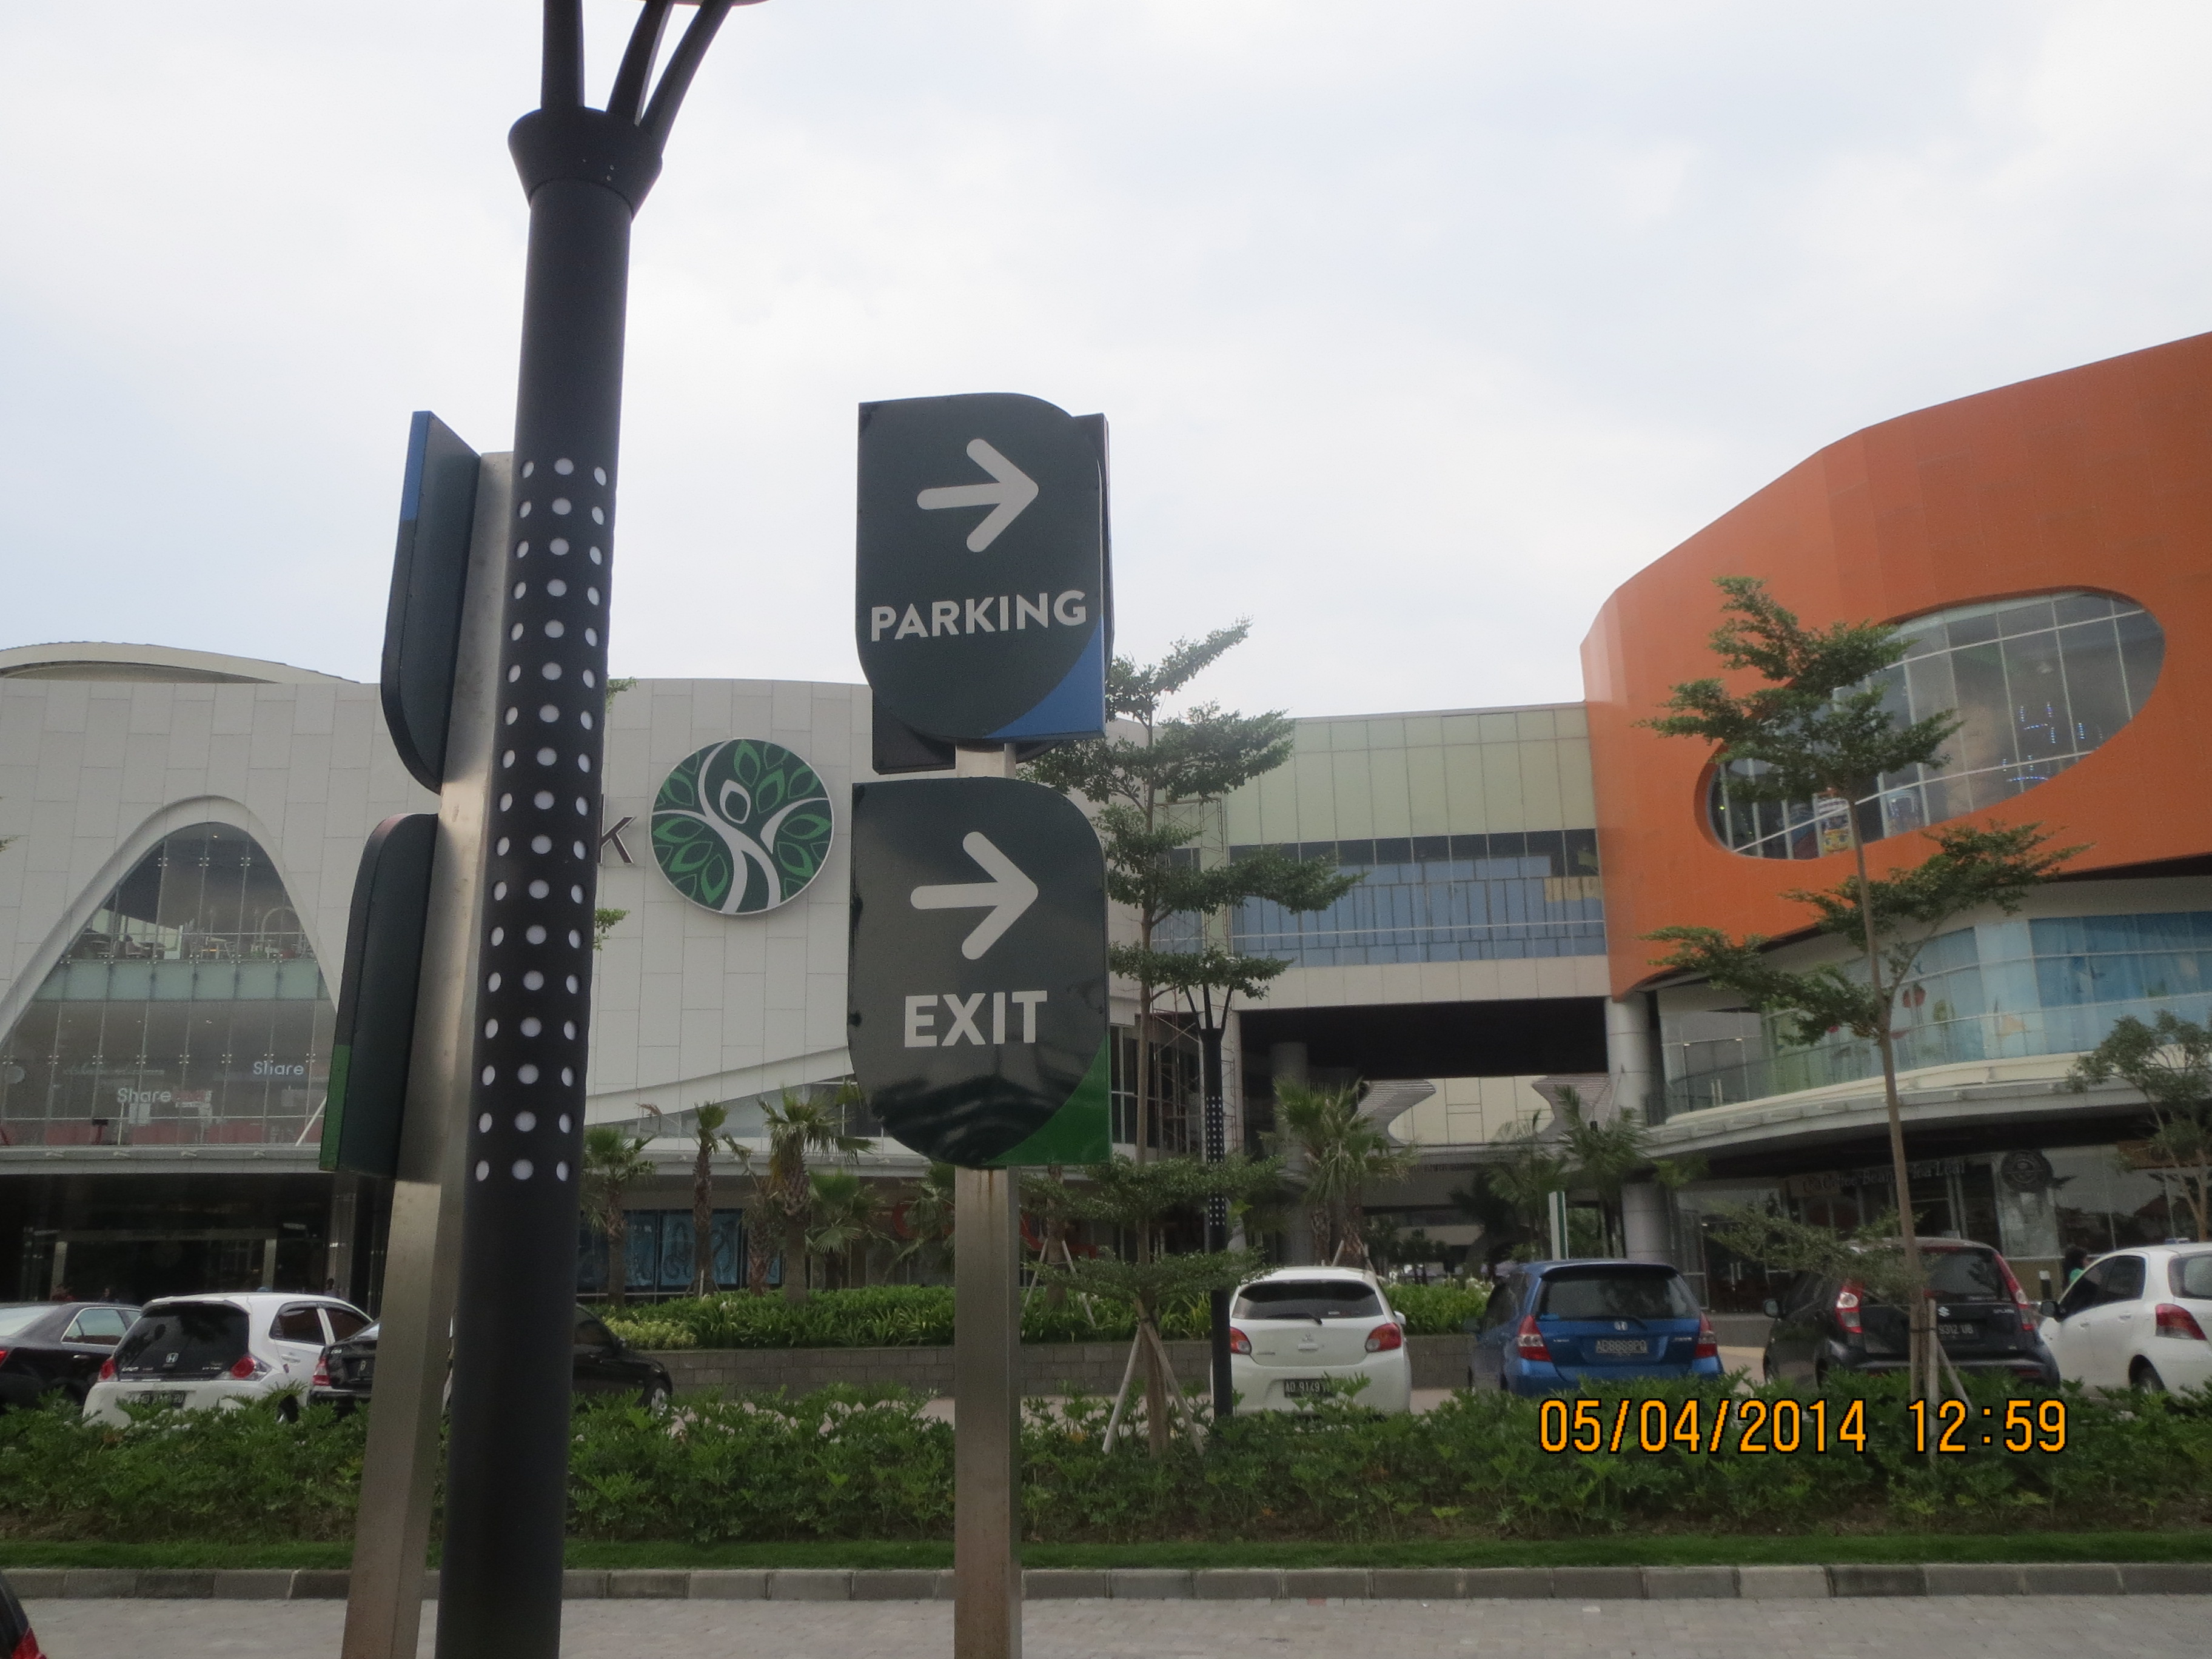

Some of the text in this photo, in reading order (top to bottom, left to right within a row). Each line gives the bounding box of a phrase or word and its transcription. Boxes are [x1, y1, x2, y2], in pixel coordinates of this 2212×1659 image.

[871, 590, 1087, 642] PARKING
[904, 990, 1048, 1048] EXIT
[253, 1061, 304, 1075] Share
[117, 1088, 171, 1103] Share
